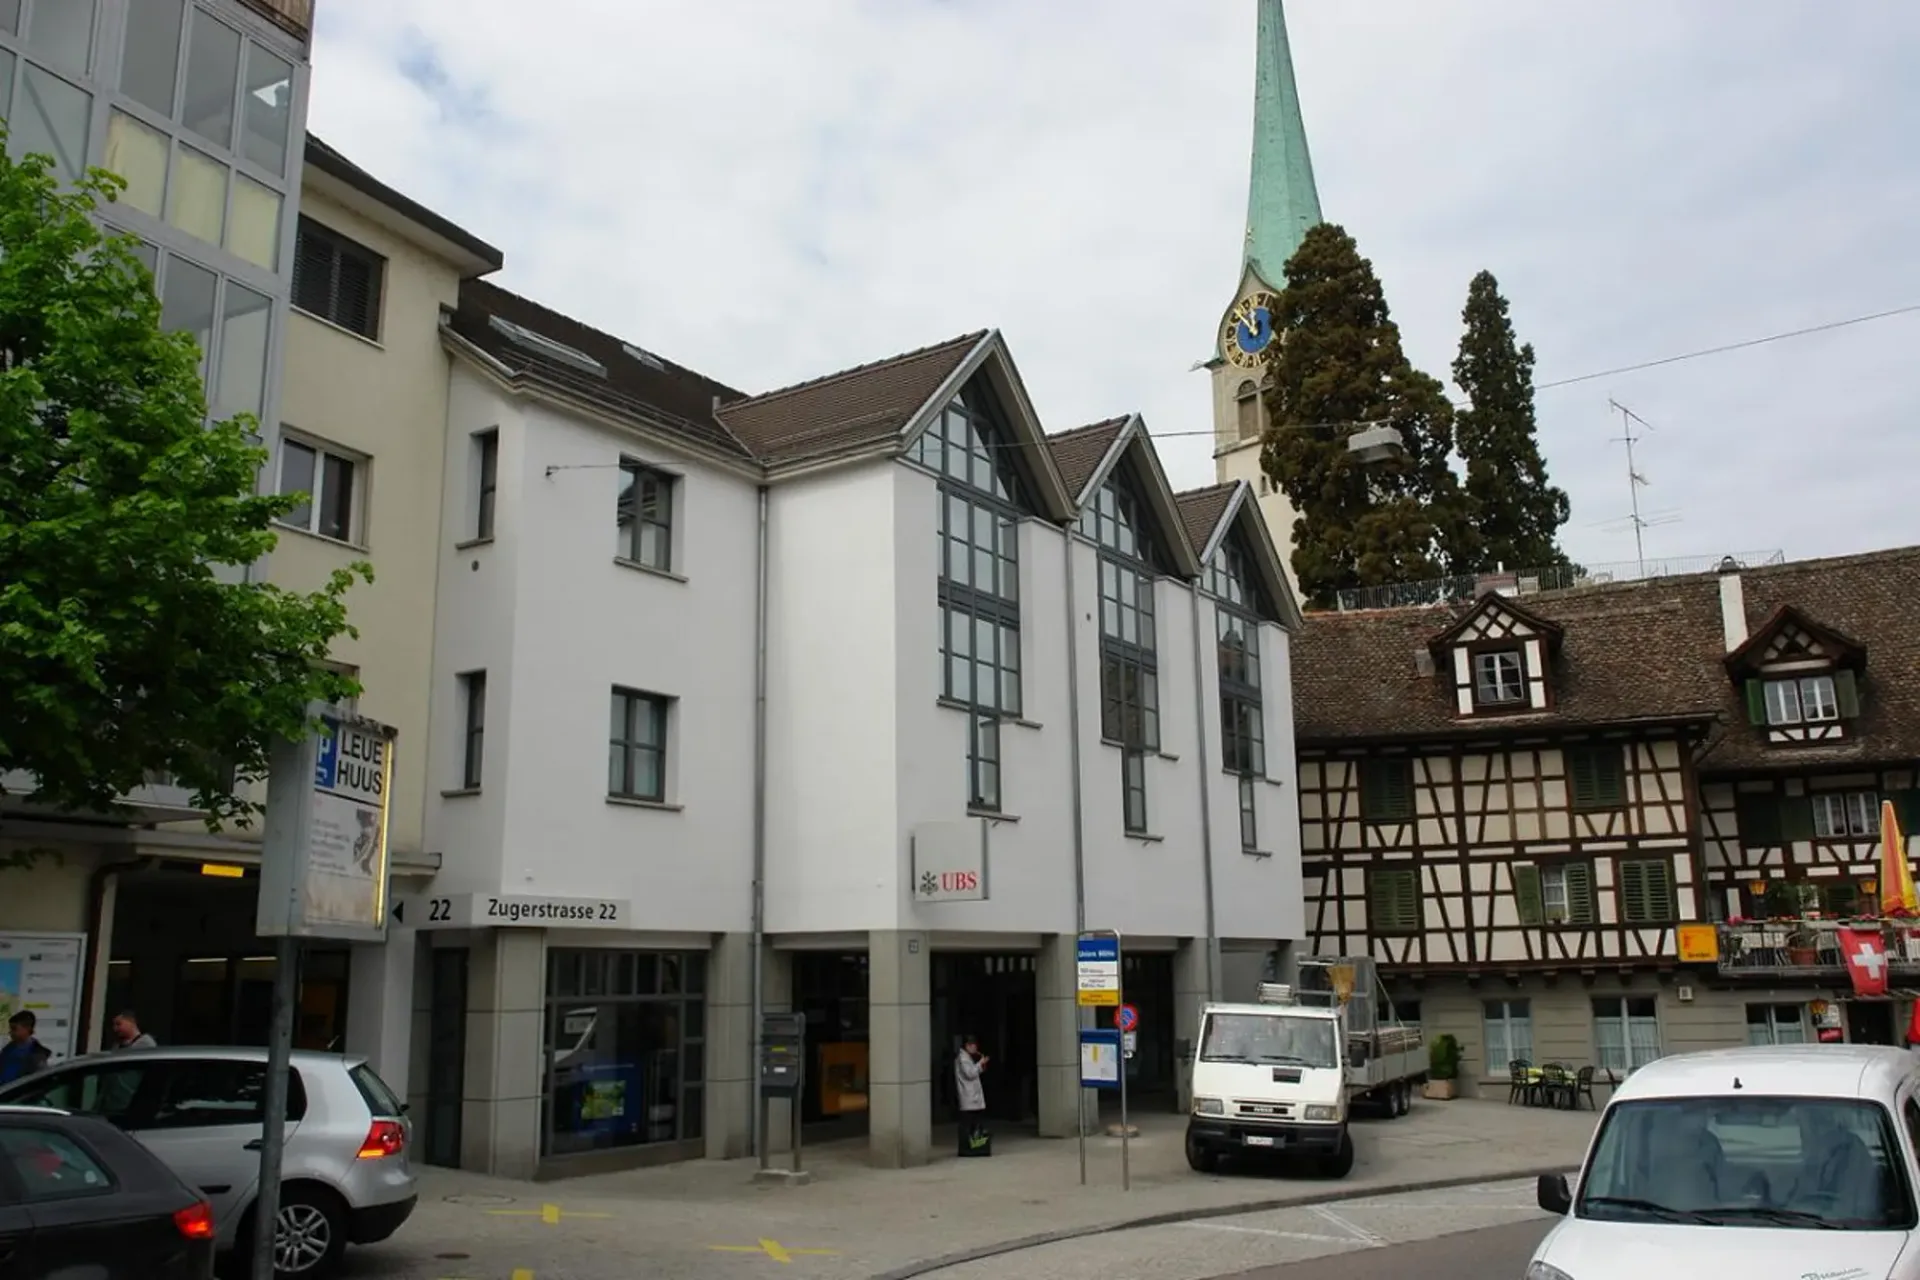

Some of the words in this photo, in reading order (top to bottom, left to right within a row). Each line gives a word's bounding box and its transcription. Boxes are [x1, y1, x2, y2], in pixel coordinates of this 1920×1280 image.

[318, 734, 331, 763] P
[341, 730, 383, 764] LEUE
[337, 760, 382, 795] HUUS
[941, 871, 977, 892] UBS
[429, 899, 451, 921] 22
[488, 899, 594, 921] Zugerstrasse
[599, 903, 617, 920] 22
